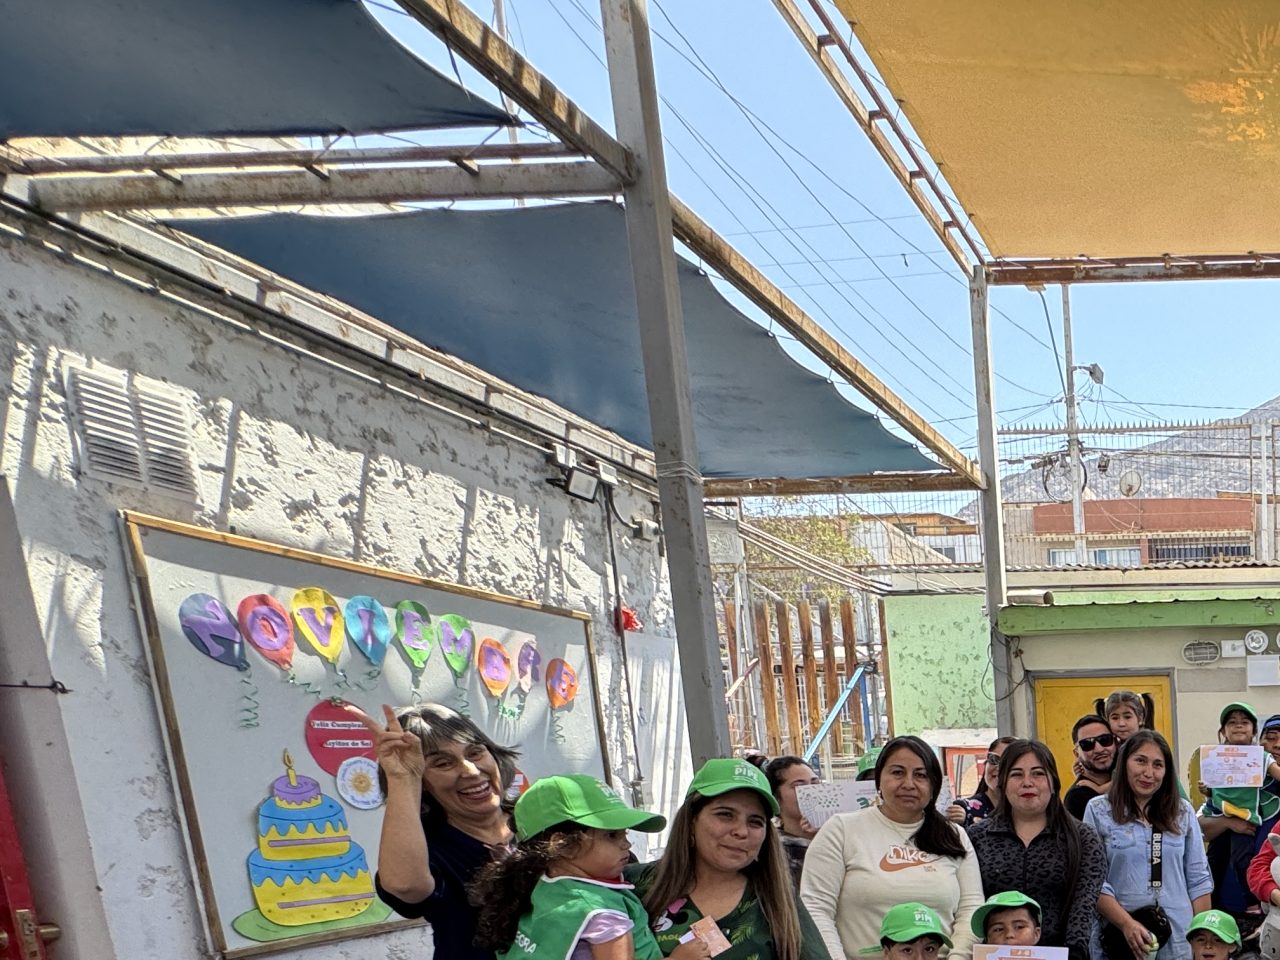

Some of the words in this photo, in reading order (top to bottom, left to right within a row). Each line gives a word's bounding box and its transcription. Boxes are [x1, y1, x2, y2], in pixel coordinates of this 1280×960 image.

[181, 600, 577, 698] NOVIEMBRE
[331, 721, 369, 730] Cumplea
[734, 766, 760, 782] PIPE
[1152, 833, 1162, 865] BUBBA
